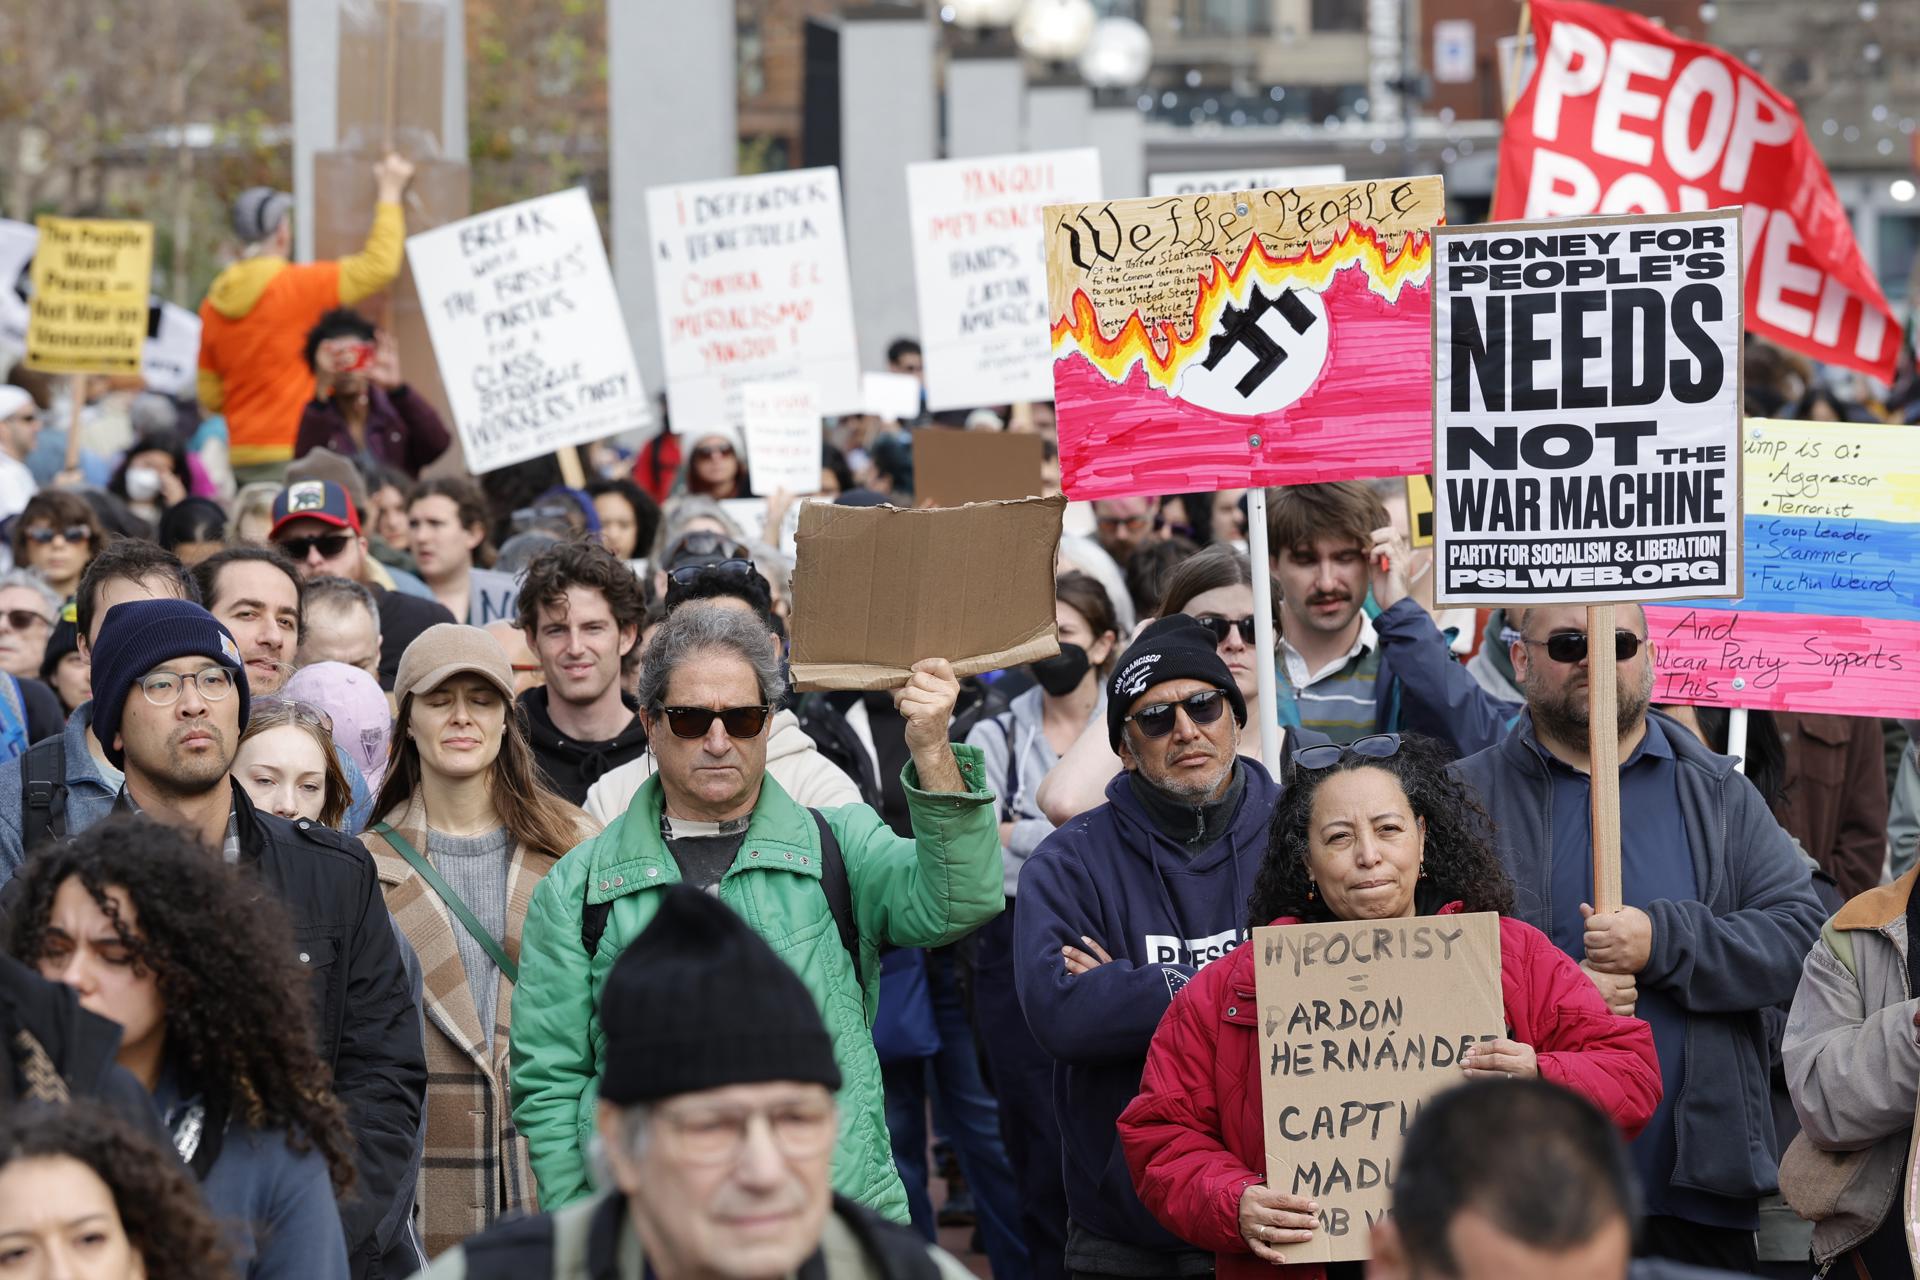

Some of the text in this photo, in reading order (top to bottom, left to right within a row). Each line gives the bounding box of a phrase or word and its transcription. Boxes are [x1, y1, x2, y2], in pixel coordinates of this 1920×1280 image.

[47, 225, 142, 247] The People
[458, 208, 558, 256] BREAK
[1055, 203, 1166, 278] We
[1448, 226, 1725, 262] MONEY FOR
[64, 252, 117, 269] Want
[1109, 265, 1122, 273] the
[1125, 255, 1157, 270] United
[1160, 245, 1194, 266] States
[44, 270, 107, 292] Peace
[1092, 277, 1103, 286] for
[1106, 273, 1120, 283] the
[1122, 271, 1154, 282] Common
[1092, 287, 1101, 295] to
[1138, 280, 1154, 289] and
[35, 301, 140, 323] Not War on
[1093, 299, 1106, 308] for
[1109, 294, 1126, 306] the
[1128, 293, 1164, 305] United
[1146, 303, 1182, 313] Article
[35, 328, 136, 349] Venezuela
[1450, 283, 1724, 412] NEEDS
[1447, 420, 1725, 470] NOT THE
[1795, 438, 1822, 459] is
[1772, 462, 1878, 498] Aggressor
[1446, 477, 1541, 532] WAR
[1550, 469, 1725, 530] MACHINE
[1771, 493, 1853, 517] Terrorist
[1768, 520, 1872, 543] Coup Leader
[1450, 536, 1720, 565] PARTY FOR SOCIALISM & LIBERATION
[1763, 539, 1864, 564] Scammer
[1450, 561, 1719, 588] PSLWEB.ORG
[1761, 565, 1906, 596] Fuckin Weird
[1667, 611, 1747, 642] And
[1122, 654, 1162, 678] FRANCISCO
[1656, 637, 1903, 689] blican Party Supports
[1661, 672, 1720, 699] This
[1157, 940, 1238, 969] PESS
[1265, 927, 1463, 976] HYPOCRISY
